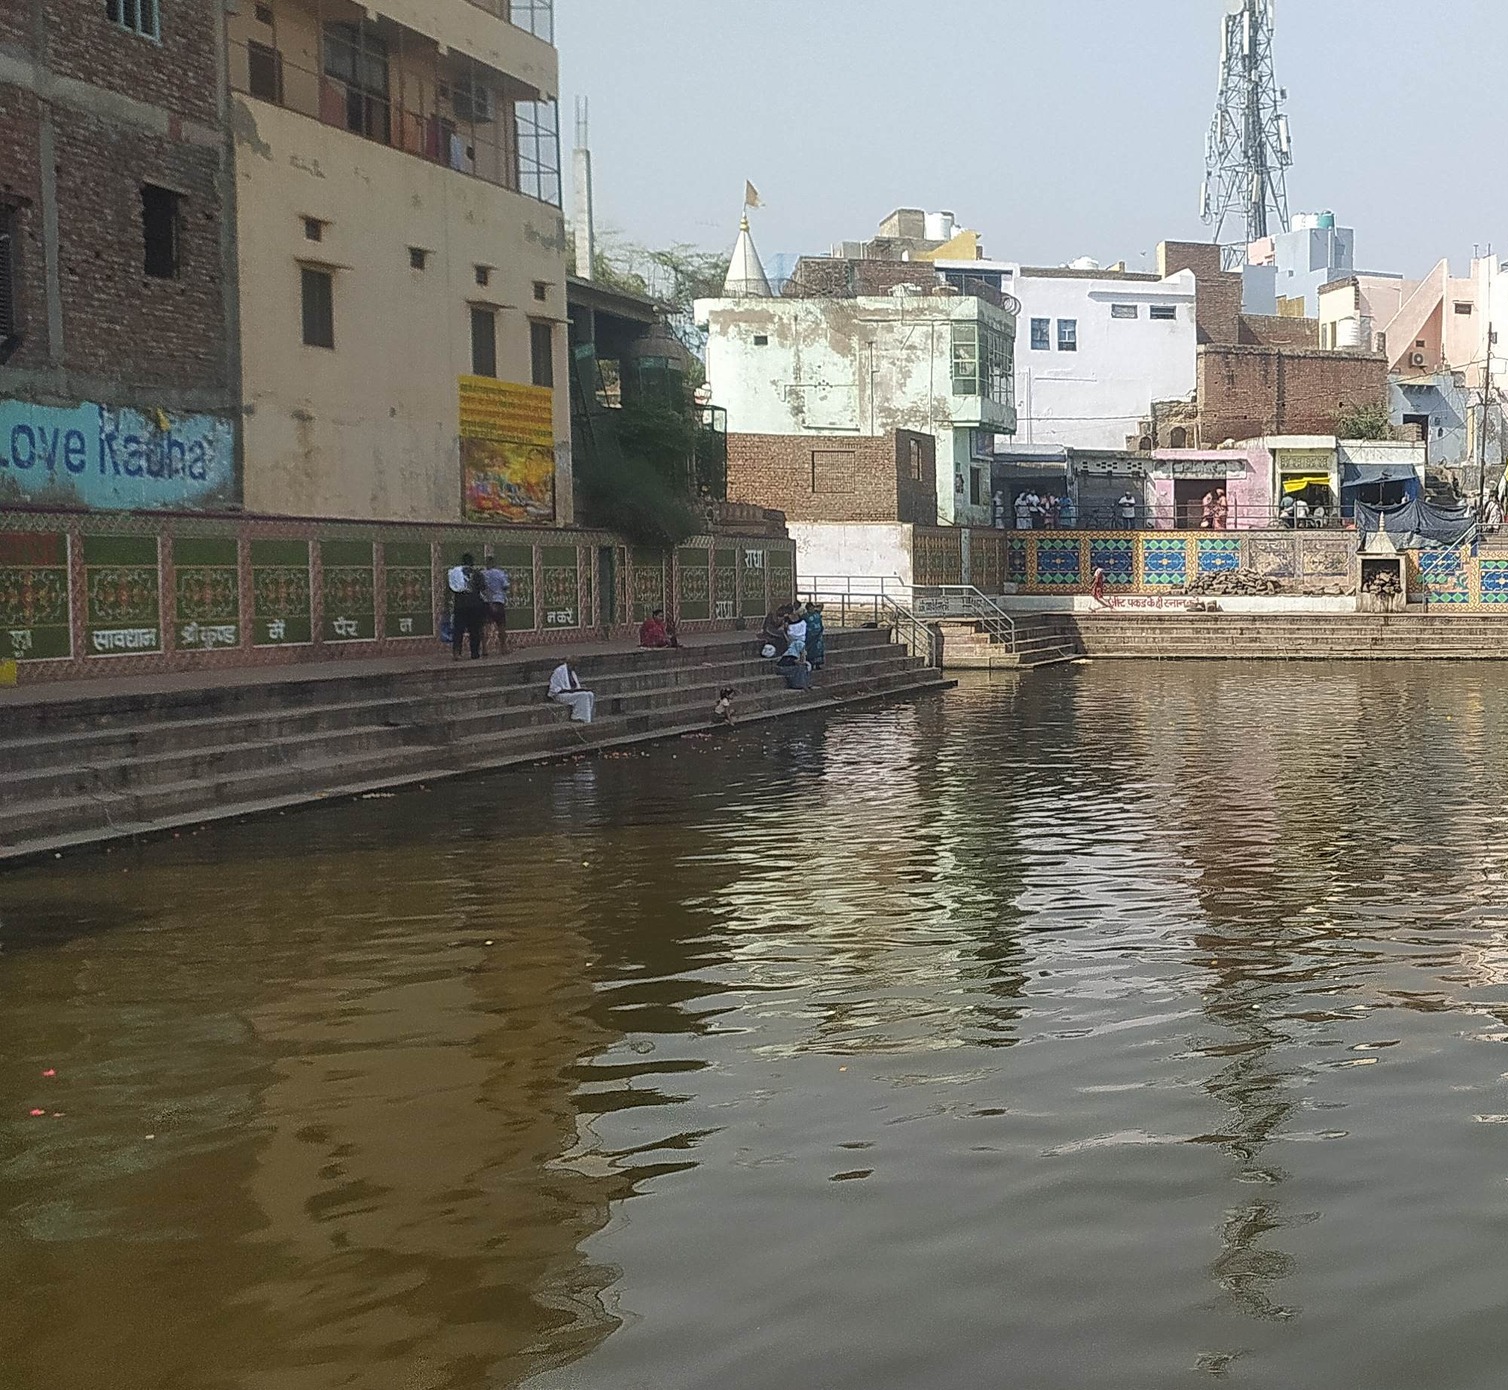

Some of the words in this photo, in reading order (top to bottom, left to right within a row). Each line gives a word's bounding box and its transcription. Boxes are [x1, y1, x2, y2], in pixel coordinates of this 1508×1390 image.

[0, 424, 87, 474] ove
[744, 549, 764, 569] राधा
[92, 627, 157, 651] सावधान
[266, 618, 286, 640] में
